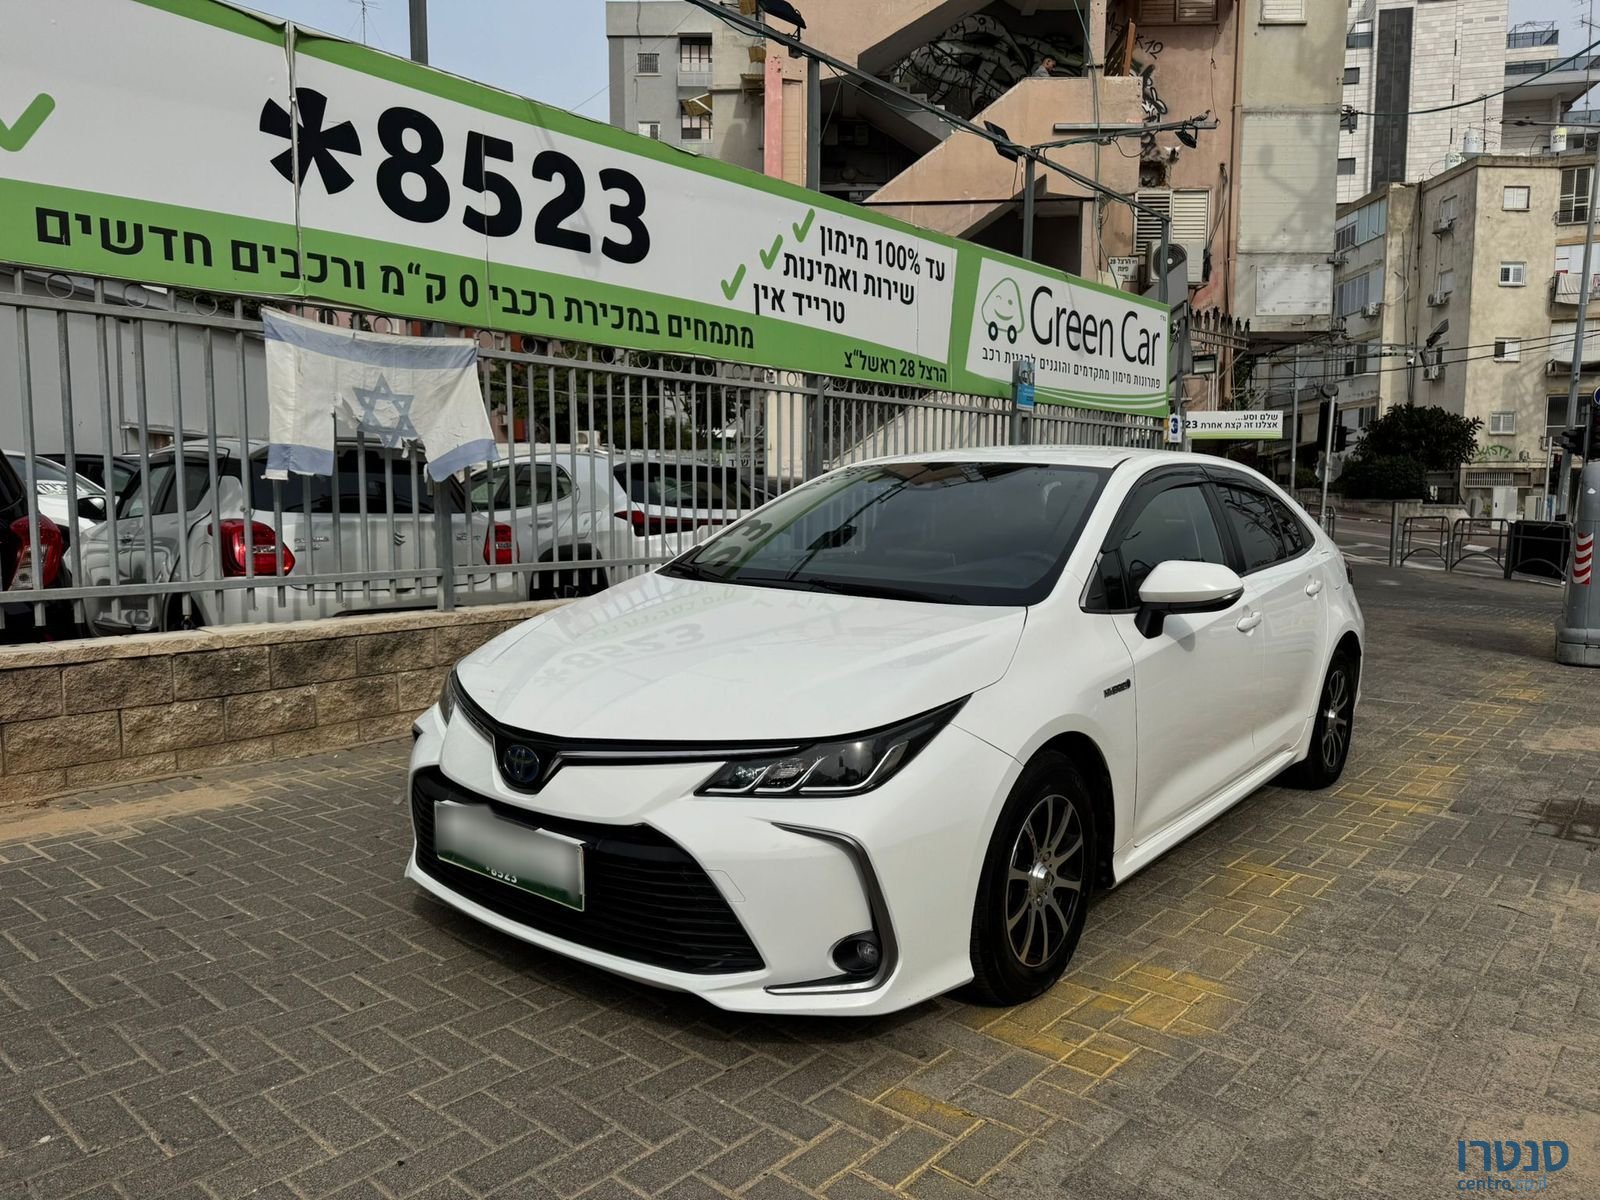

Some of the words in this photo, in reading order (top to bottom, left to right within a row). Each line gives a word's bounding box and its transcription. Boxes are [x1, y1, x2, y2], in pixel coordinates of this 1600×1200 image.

[35, 206, 213, 268] חדשים
[819, 225, 869, 261] מימון
[230, 239, 365, 291] ורכבים
[875, 239, 921, 275] 100%
[925, 256, 945, 282] עד
[783, 252, 858, 293] ואמינות
[458, 274, 479, 308] 0
[488, 284, 555, 320] רכבי
[753, 283, 786, 316] אין
[863, 273, 915, 305] שירות
[564, 296, 660, 335] במכירת
[792, 291, 846, 324] טרייד
[667, 313, 754, 350] מתמחים
[1030, 285, 1114, 358] Green
[1121, 310, 1161, 367] Car
[899, 358, 916, 379] 28
[982, 346, 1001, 363] רכב
[1039, 358, 1071, 375] והוגנים
[918, 359, 948, 384] הרצל
[1073, 367, 1110, 383] מתקדמים
[1112, 371, 1132, 386] מימון
[1133, 375, 1161, 389] פתרונות
[1200, 421, 1223, 429] אחרת
[1224, 421, 1242, 431] קצת
[1243, 421, 1253, 429] זה
[1255, 420, 1279, 429] אצלנו
[1259, 413, 1279, 421] שלם
